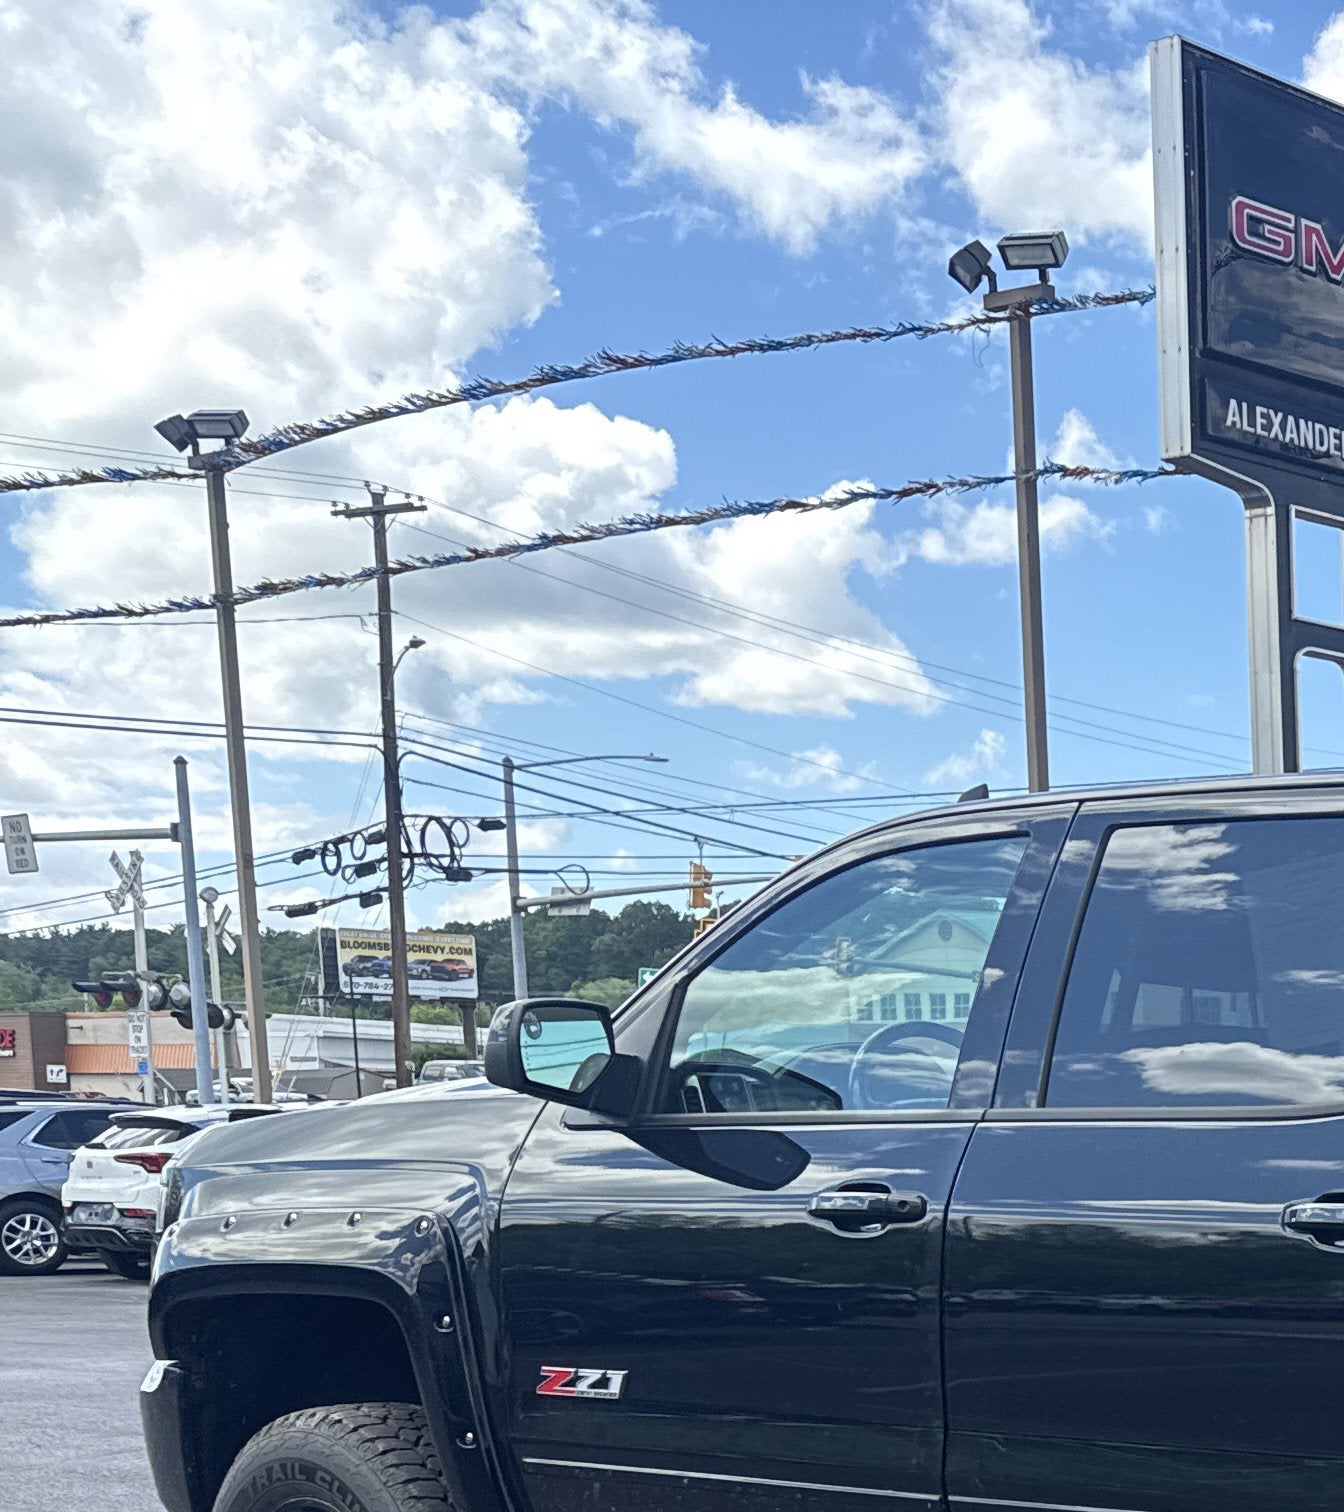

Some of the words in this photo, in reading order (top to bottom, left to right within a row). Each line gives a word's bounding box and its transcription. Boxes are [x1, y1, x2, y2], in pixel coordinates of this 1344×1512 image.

[9, 820, 22, 834] NO
[15, 846, 26, 856] ON
[15, 858, 29, 868] RED
[536, 1366, 629, 1400] Z71
[247, 1462, 307, 1500] TRAIL
